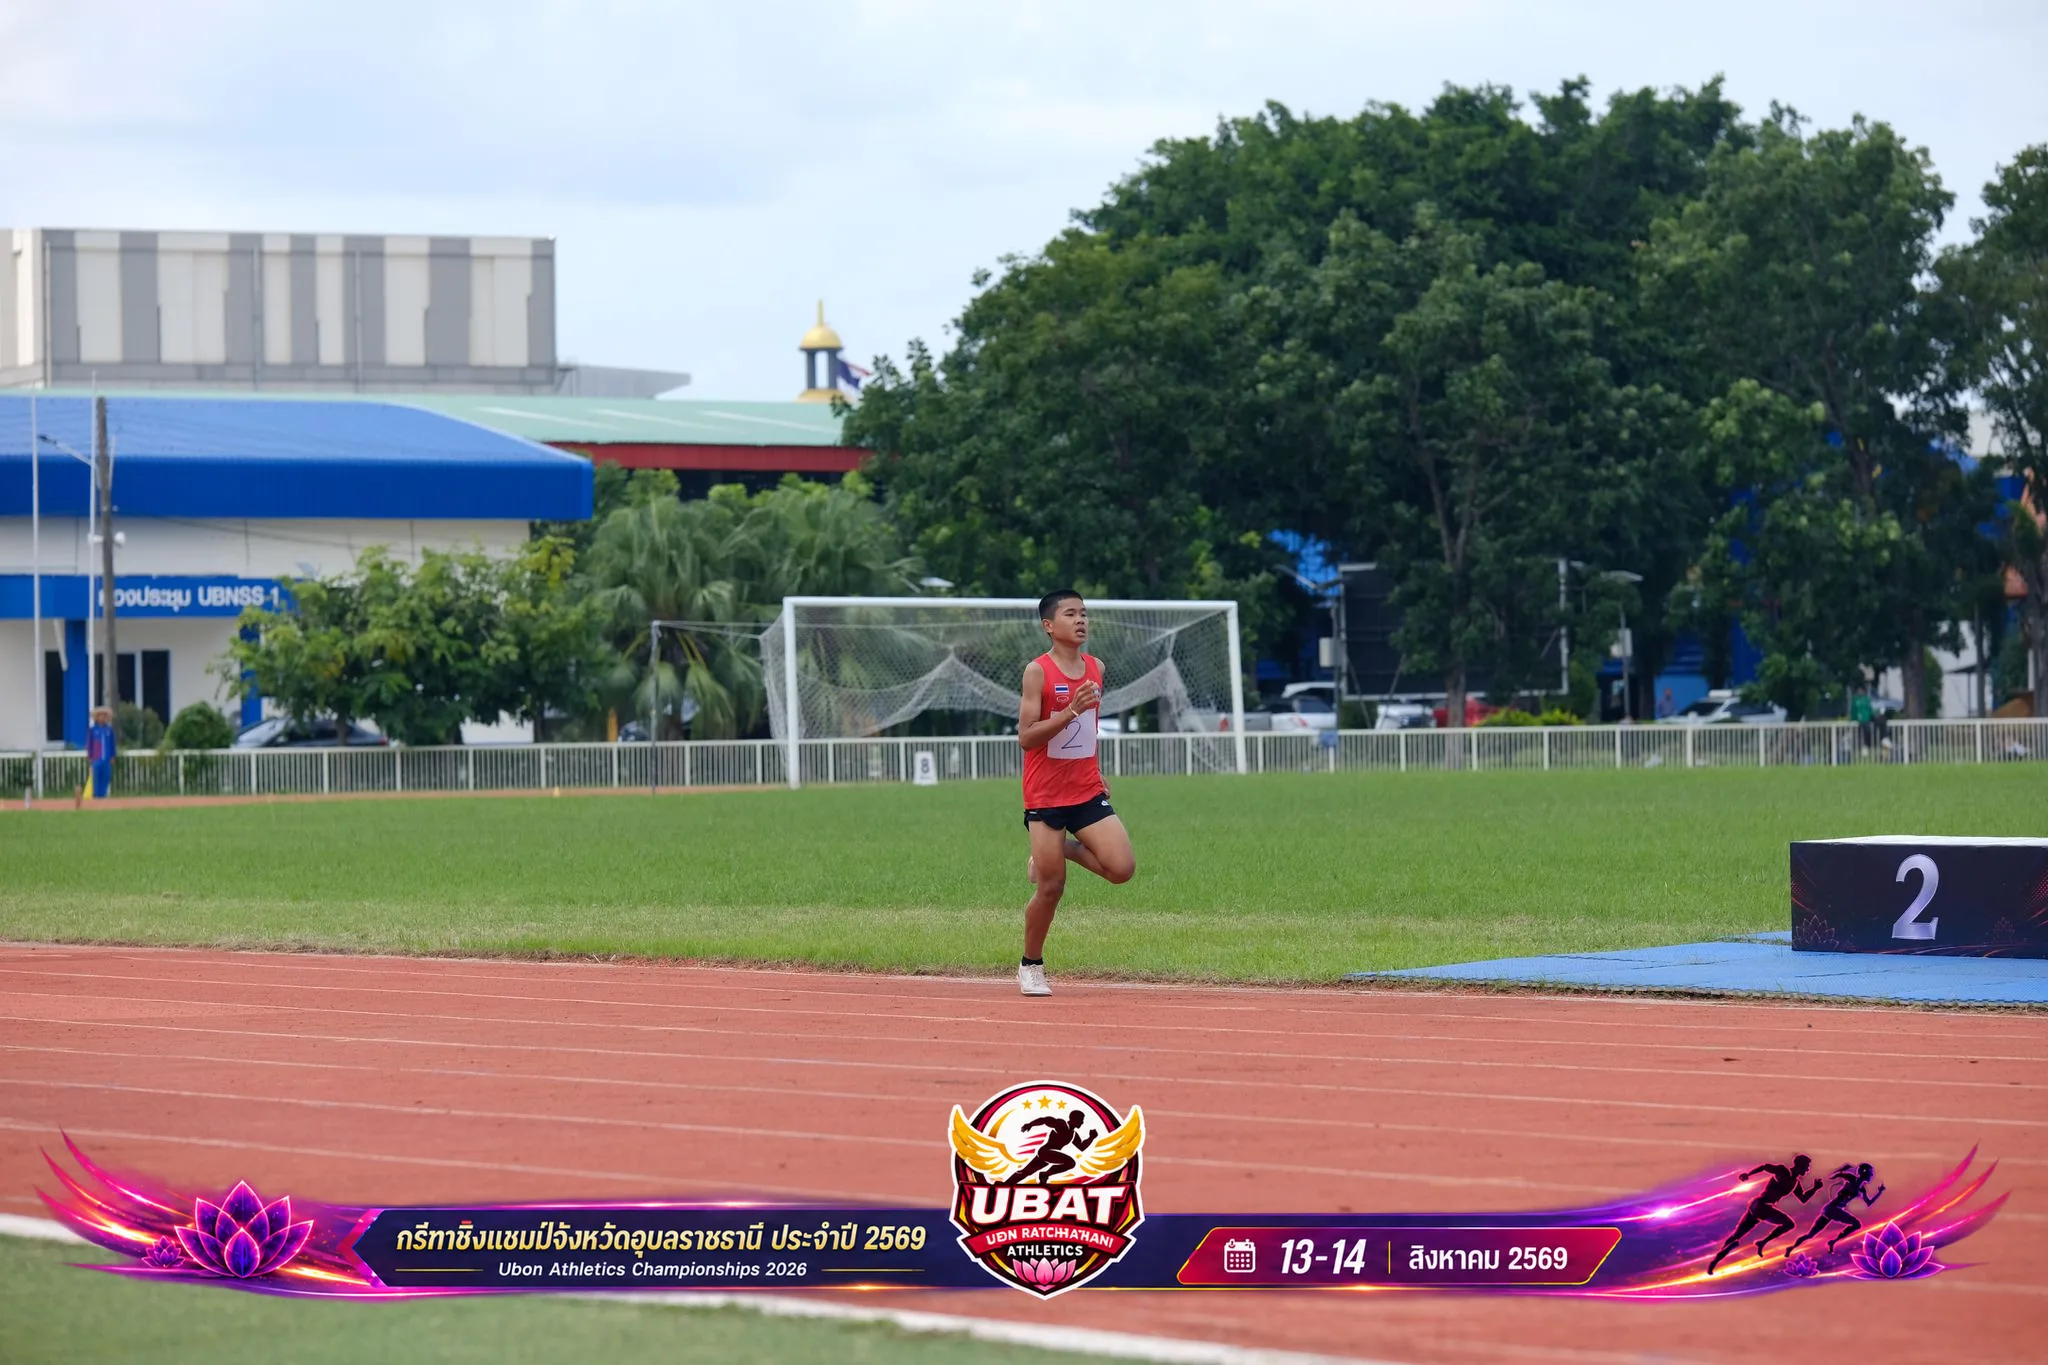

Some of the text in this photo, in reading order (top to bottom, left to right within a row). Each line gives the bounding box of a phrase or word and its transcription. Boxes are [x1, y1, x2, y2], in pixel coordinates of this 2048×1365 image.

[1060, 720, 1083, 750] 2
[920, 757, 930, 774] 8
[1891, 853, 1940, 941] 2
